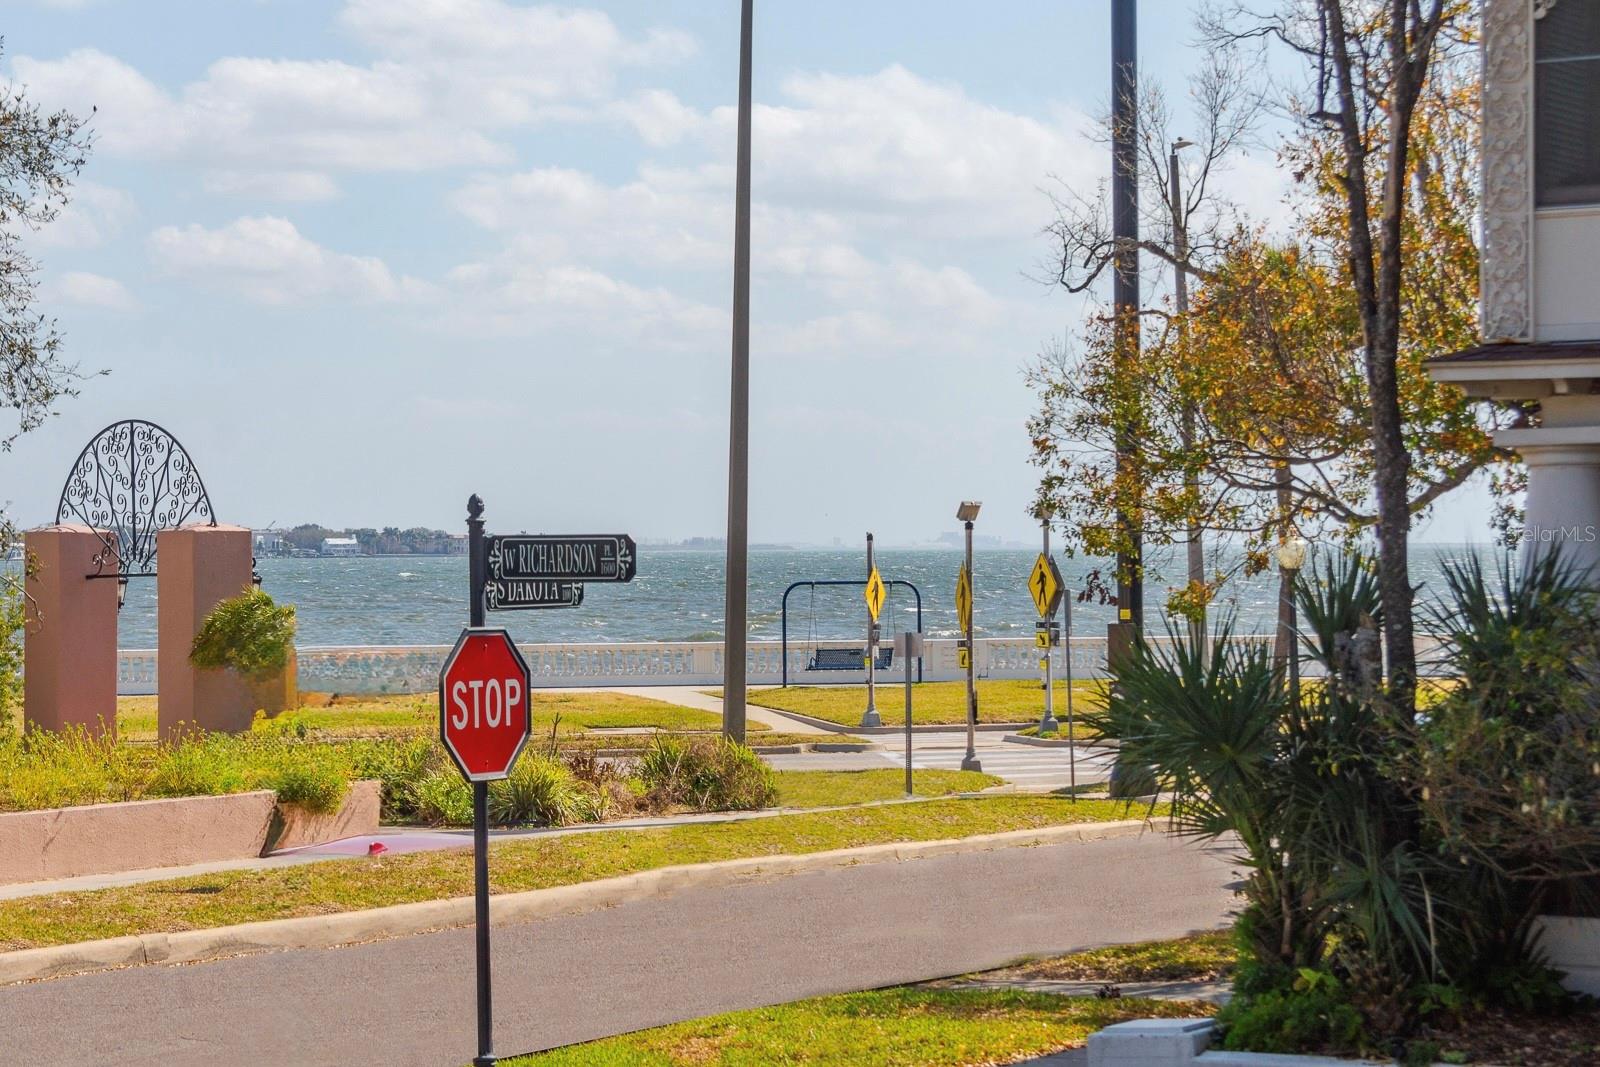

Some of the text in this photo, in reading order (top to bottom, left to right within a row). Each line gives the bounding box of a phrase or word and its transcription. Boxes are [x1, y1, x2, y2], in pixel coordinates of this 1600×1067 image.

[504, 544, 597, 574] W RICHARDSON
[452, 678, 521, 730] STOP
